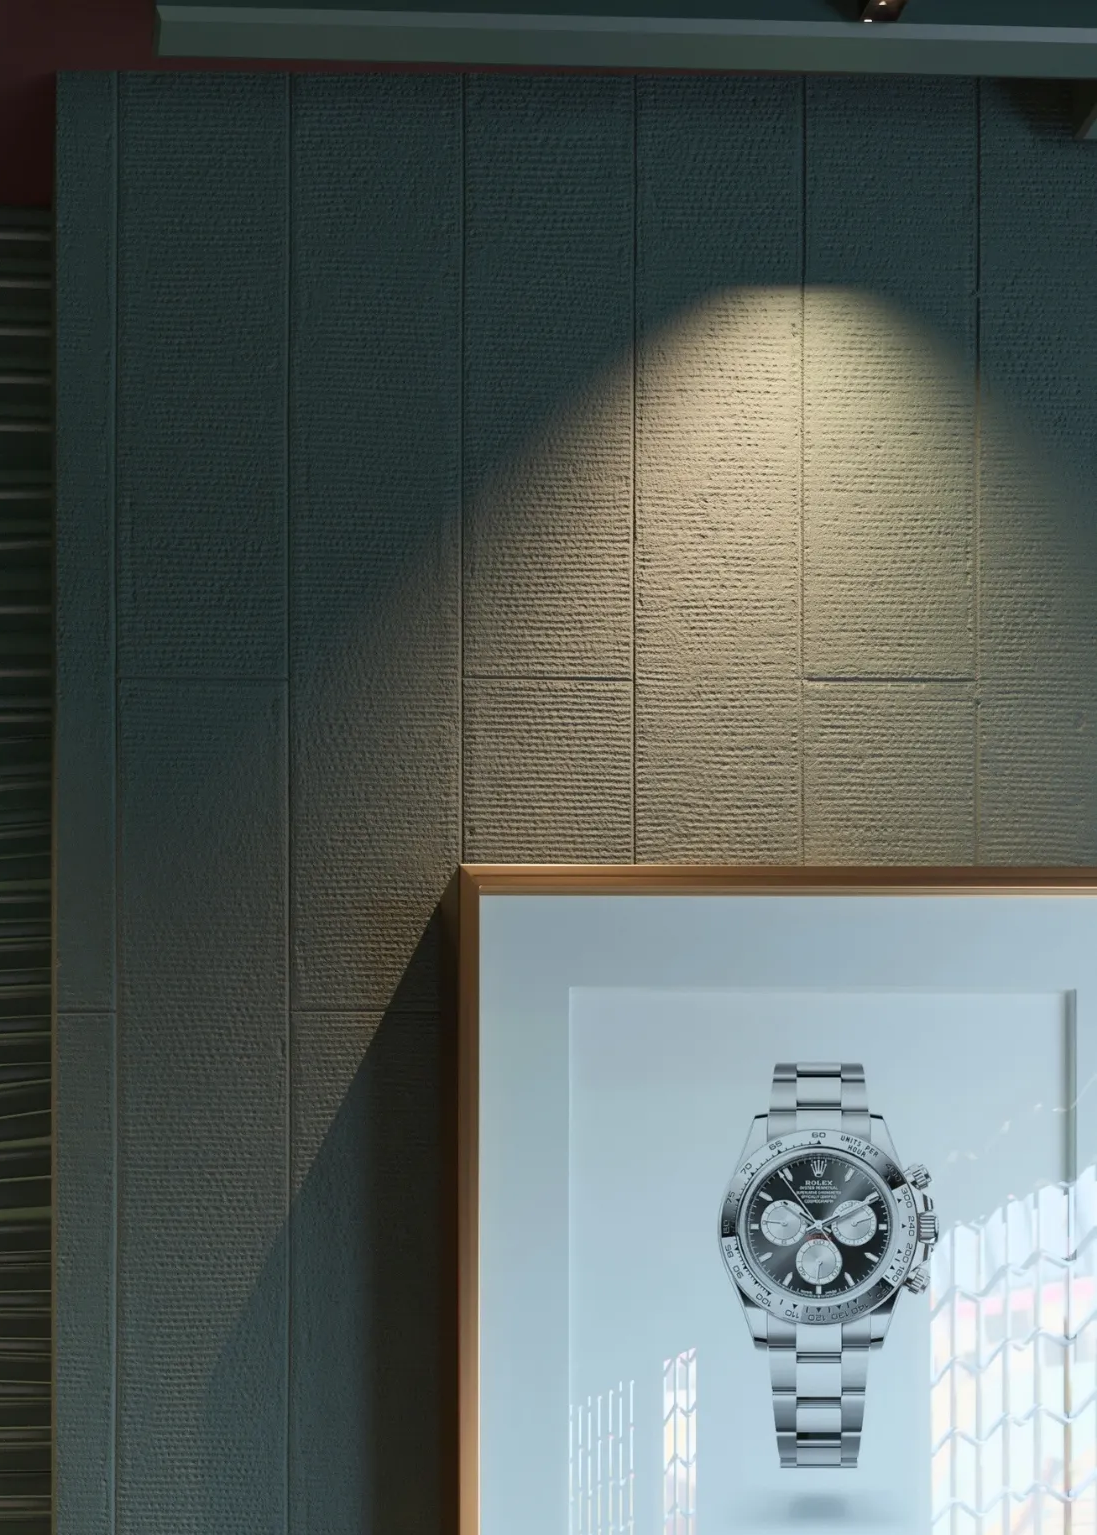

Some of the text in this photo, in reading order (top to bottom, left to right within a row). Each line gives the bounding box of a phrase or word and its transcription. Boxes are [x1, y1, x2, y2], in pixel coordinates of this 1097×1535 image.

[811, 1131, 827, 1139] 60
[768, 1140, 783, 1151] 65
[840, 1134, 879, 1157] UNITS PER
[847, 1144, 866, 1157] HOUR
[740, 1162, 753, 1175] 70
[900, 1187, 913, 1209] 300
[907, 1215, 915, 1237] 240
[902, 1242, 914, 1264] 200
[732, 1264, 744, 1279] 90
[891, 1266, 905, 1283] 180
[755, 1292, 772, 1308] 100
